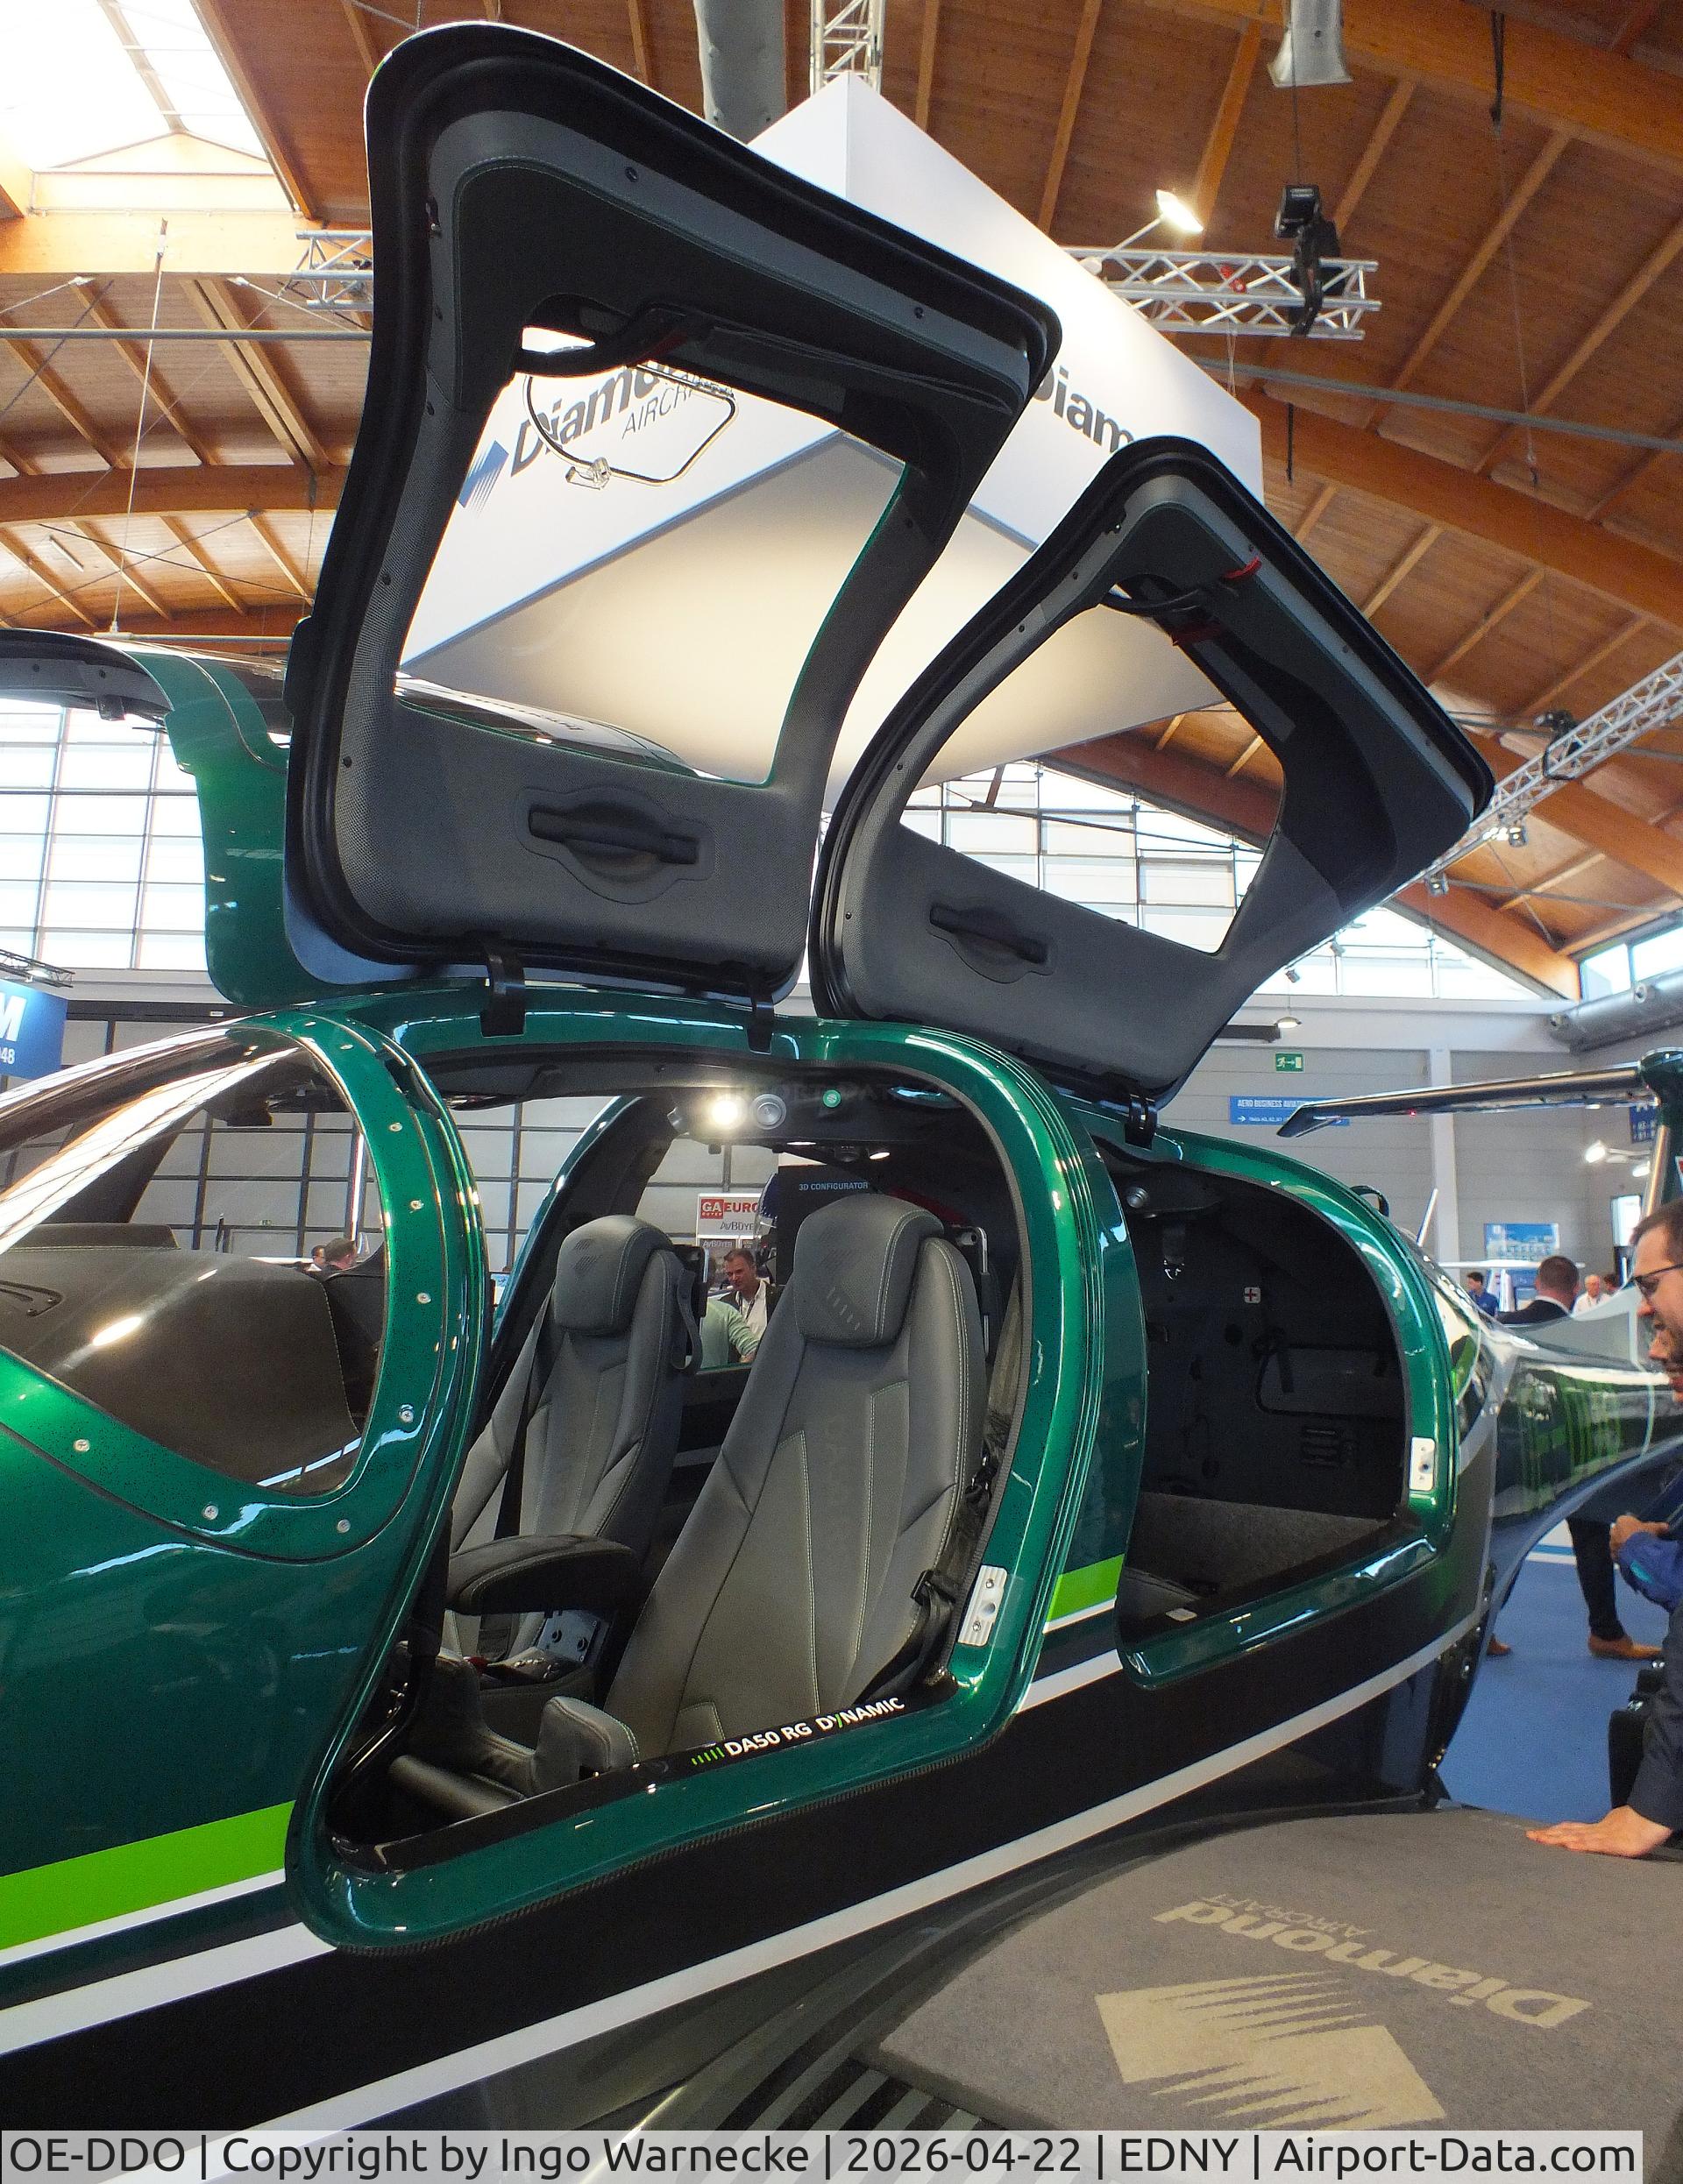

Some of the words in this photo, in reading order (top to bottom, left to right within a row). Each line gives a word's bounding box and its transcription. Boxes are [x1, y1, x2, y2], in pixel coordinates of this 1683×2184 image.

[810, 1181, 869, 1191] CONFIGURATOR
[702, 1202, 722, 1212] GA
[724, 1730, 780, 1756] DA50
[780, 1722, 813, 1741] RG
[815, 1697, 905, 1729] DYNAMIC
[1152, 1900, 1594, 2029] Diamond
